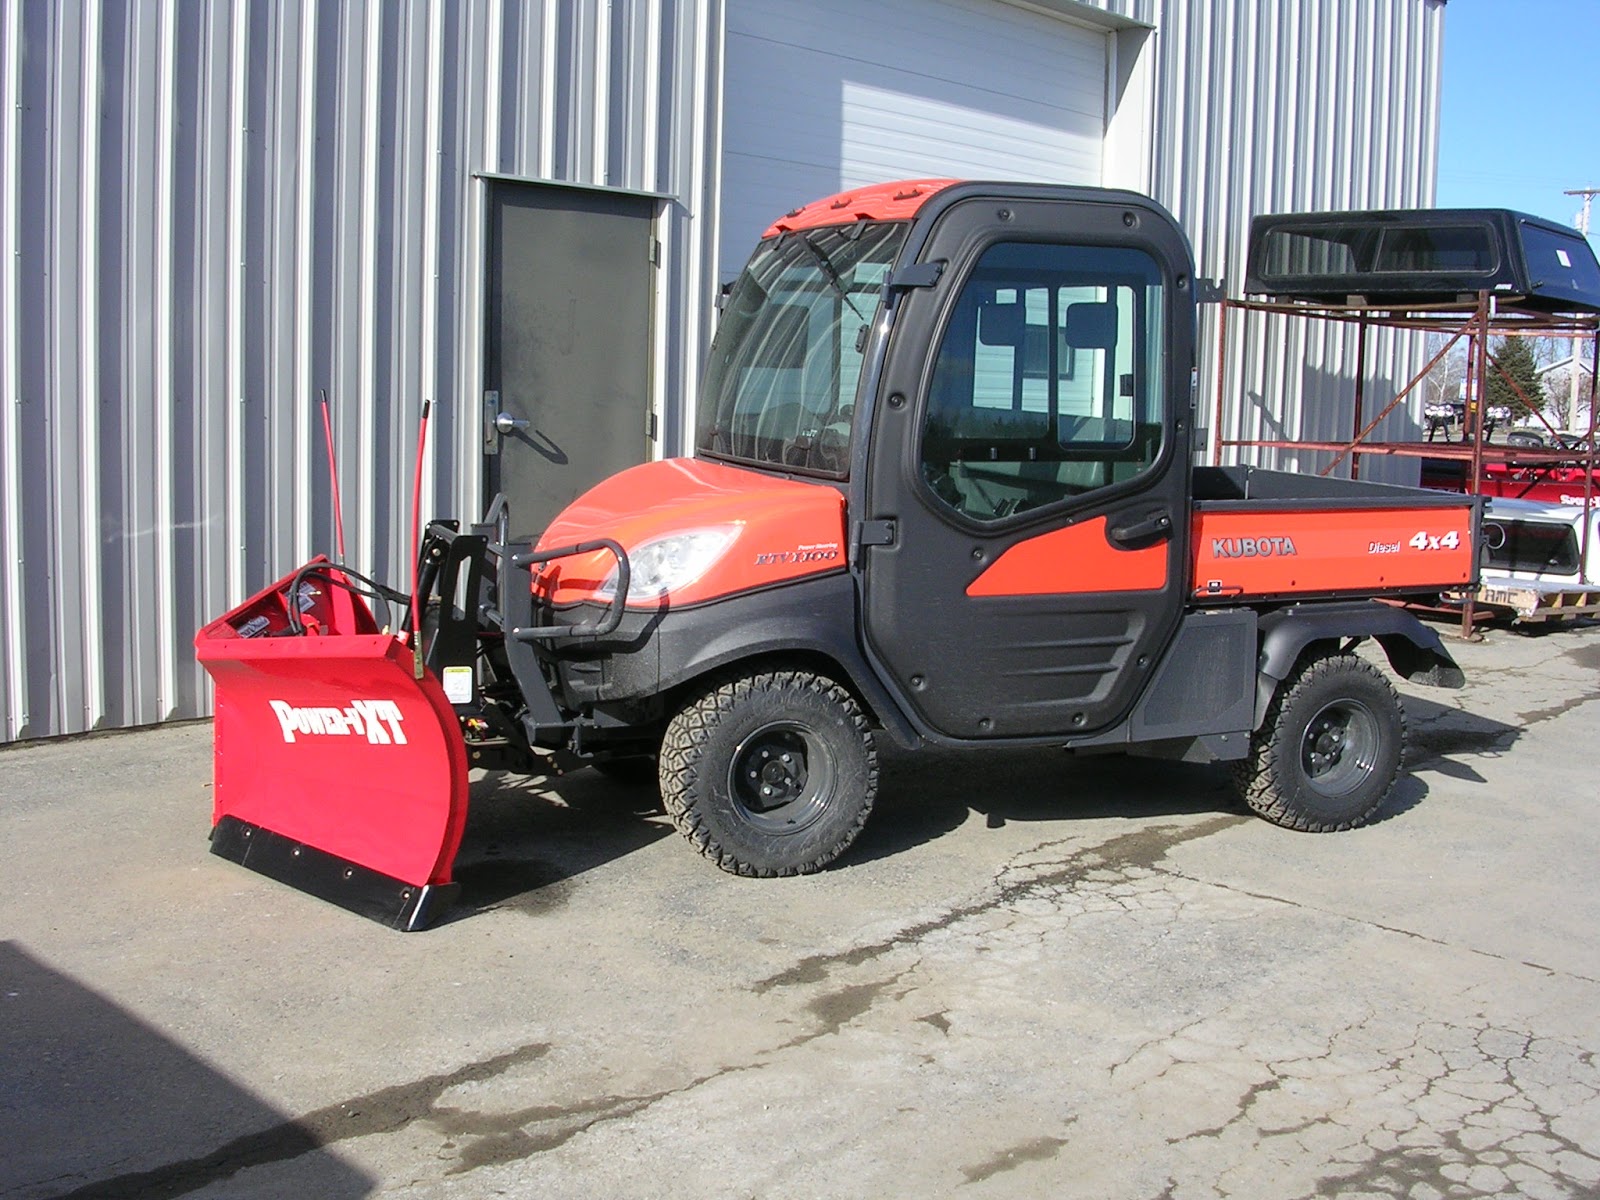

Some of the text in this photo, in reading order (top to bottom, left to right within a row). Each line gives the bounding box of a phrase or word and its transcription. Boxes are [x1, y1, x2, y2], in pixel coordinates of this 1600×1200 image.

[1212, 536, 1297, 558] KUBOTA
[1368, 530, 1460, 554] Diesel 4x4
[755, 551, 838, 565] RTV1100
